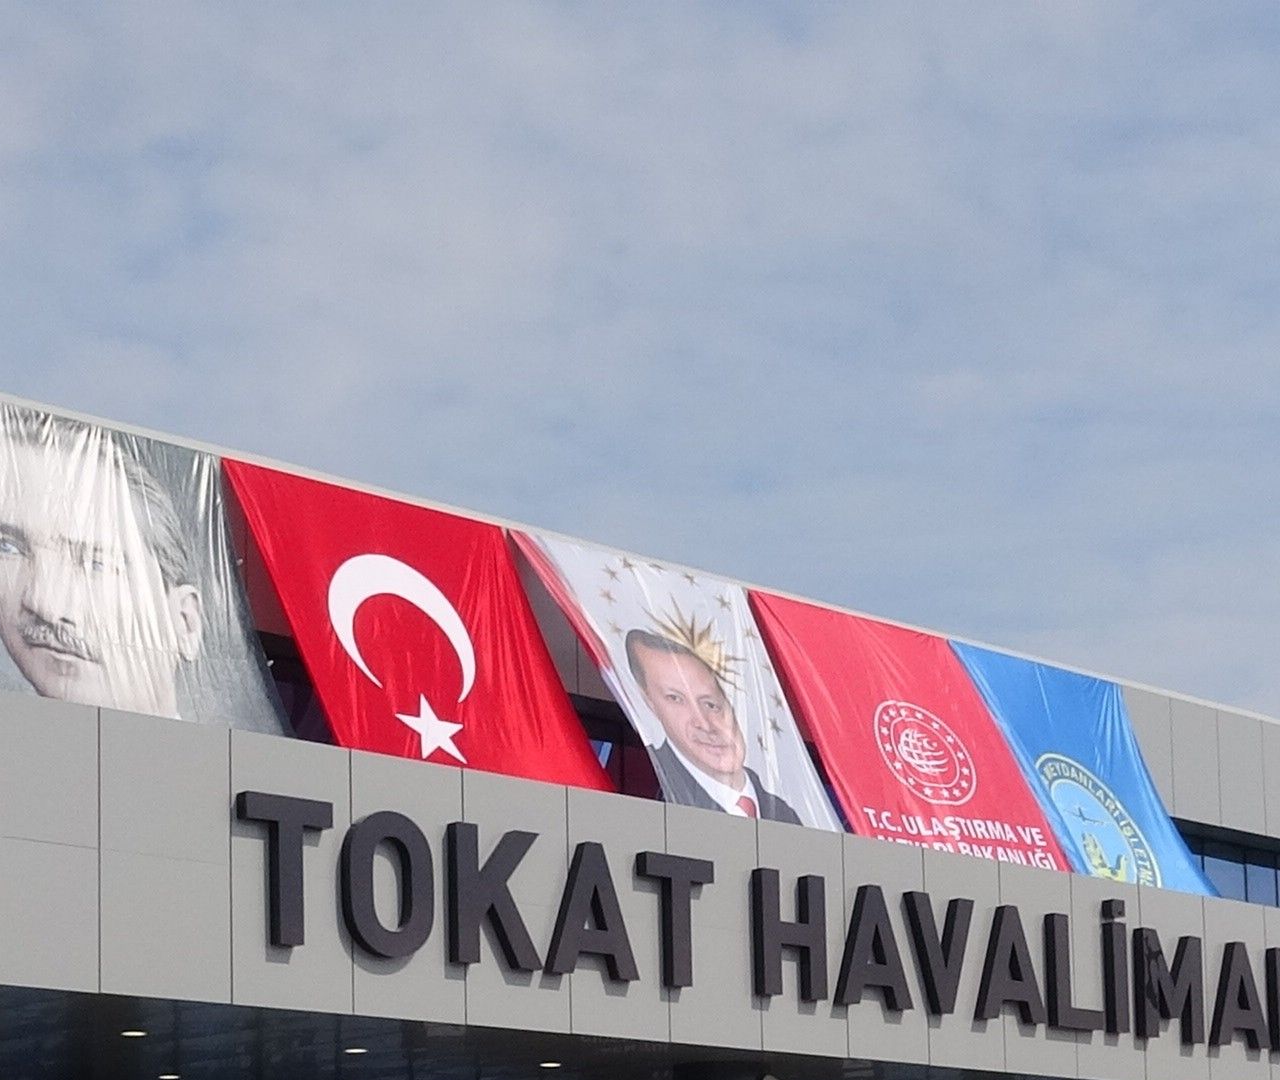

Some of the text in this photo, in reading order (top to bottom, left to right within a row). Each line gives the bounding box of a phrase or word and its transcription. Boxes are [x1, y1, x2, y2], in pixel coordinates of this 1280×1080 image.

[863, 807, 1047, 847] T.C. ULAŞTIRMA VE
[236, 790, 714, 988] TOKAT
